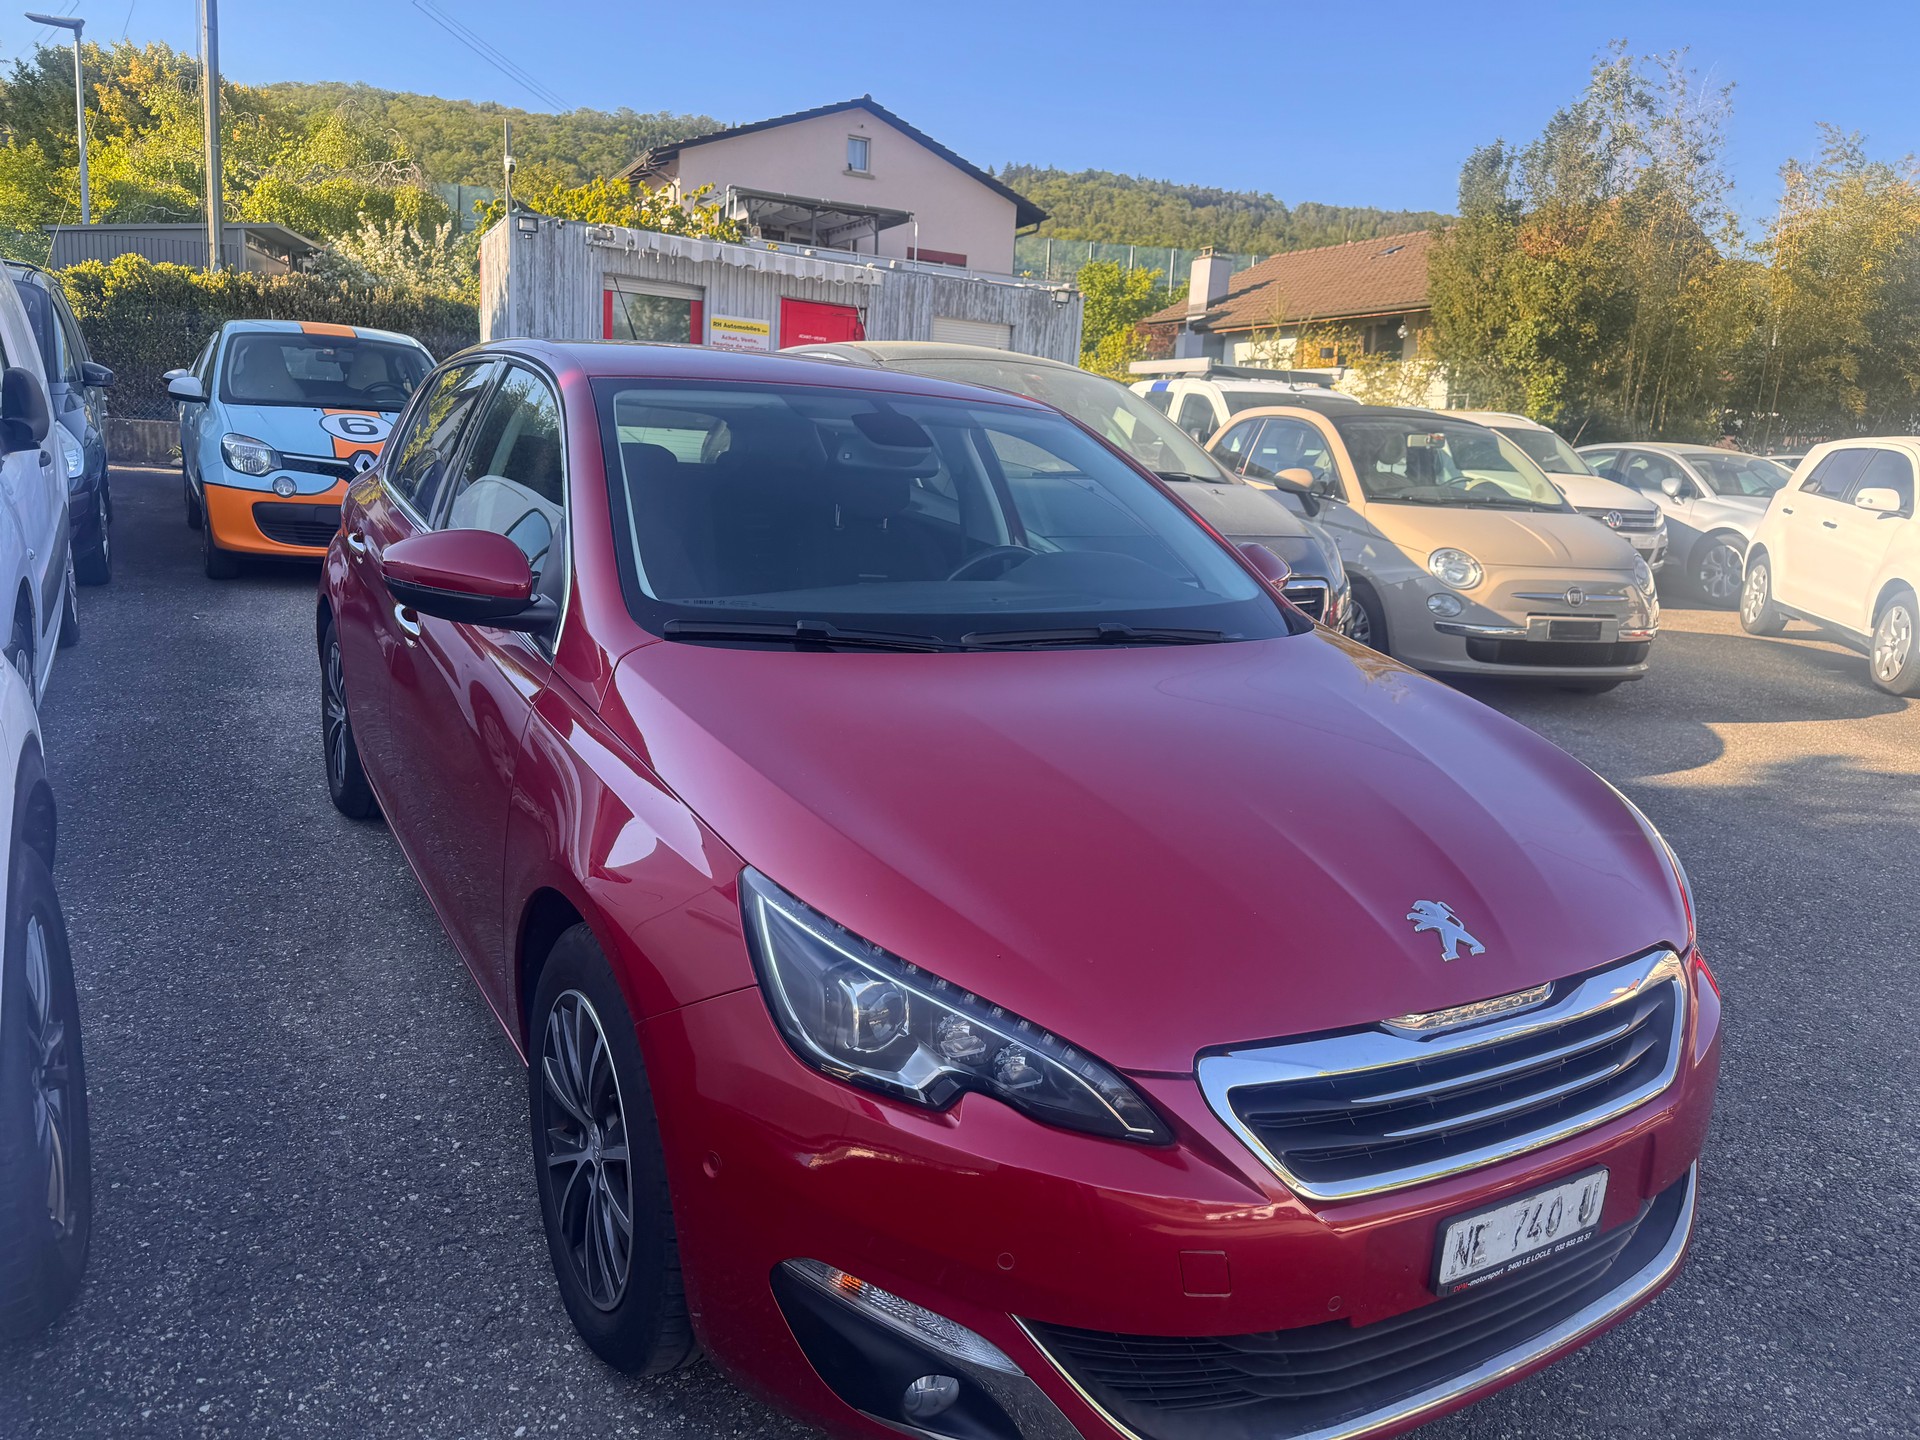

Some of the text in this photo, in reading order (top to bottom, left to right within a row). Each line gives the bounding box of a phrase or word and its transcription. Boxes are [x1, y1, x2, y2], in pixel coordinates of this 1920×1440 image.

[723, 322, 761, 332] Automobiles
[339, 417, 379, 436] 6
[1435, 993, 1537, 1026] PEUGEOT
[1449, 1182, 1600, 1275] NE 740 U
[1507, 1260, 1522, 1272] 2400
[1522, 1255, 1532, 1266] LE
[1531, 1247, 1552, 1263] LOCLE
[1554, 1242, 1565, 1252] 032
[1576, 1234, 1586, 1244] 22
